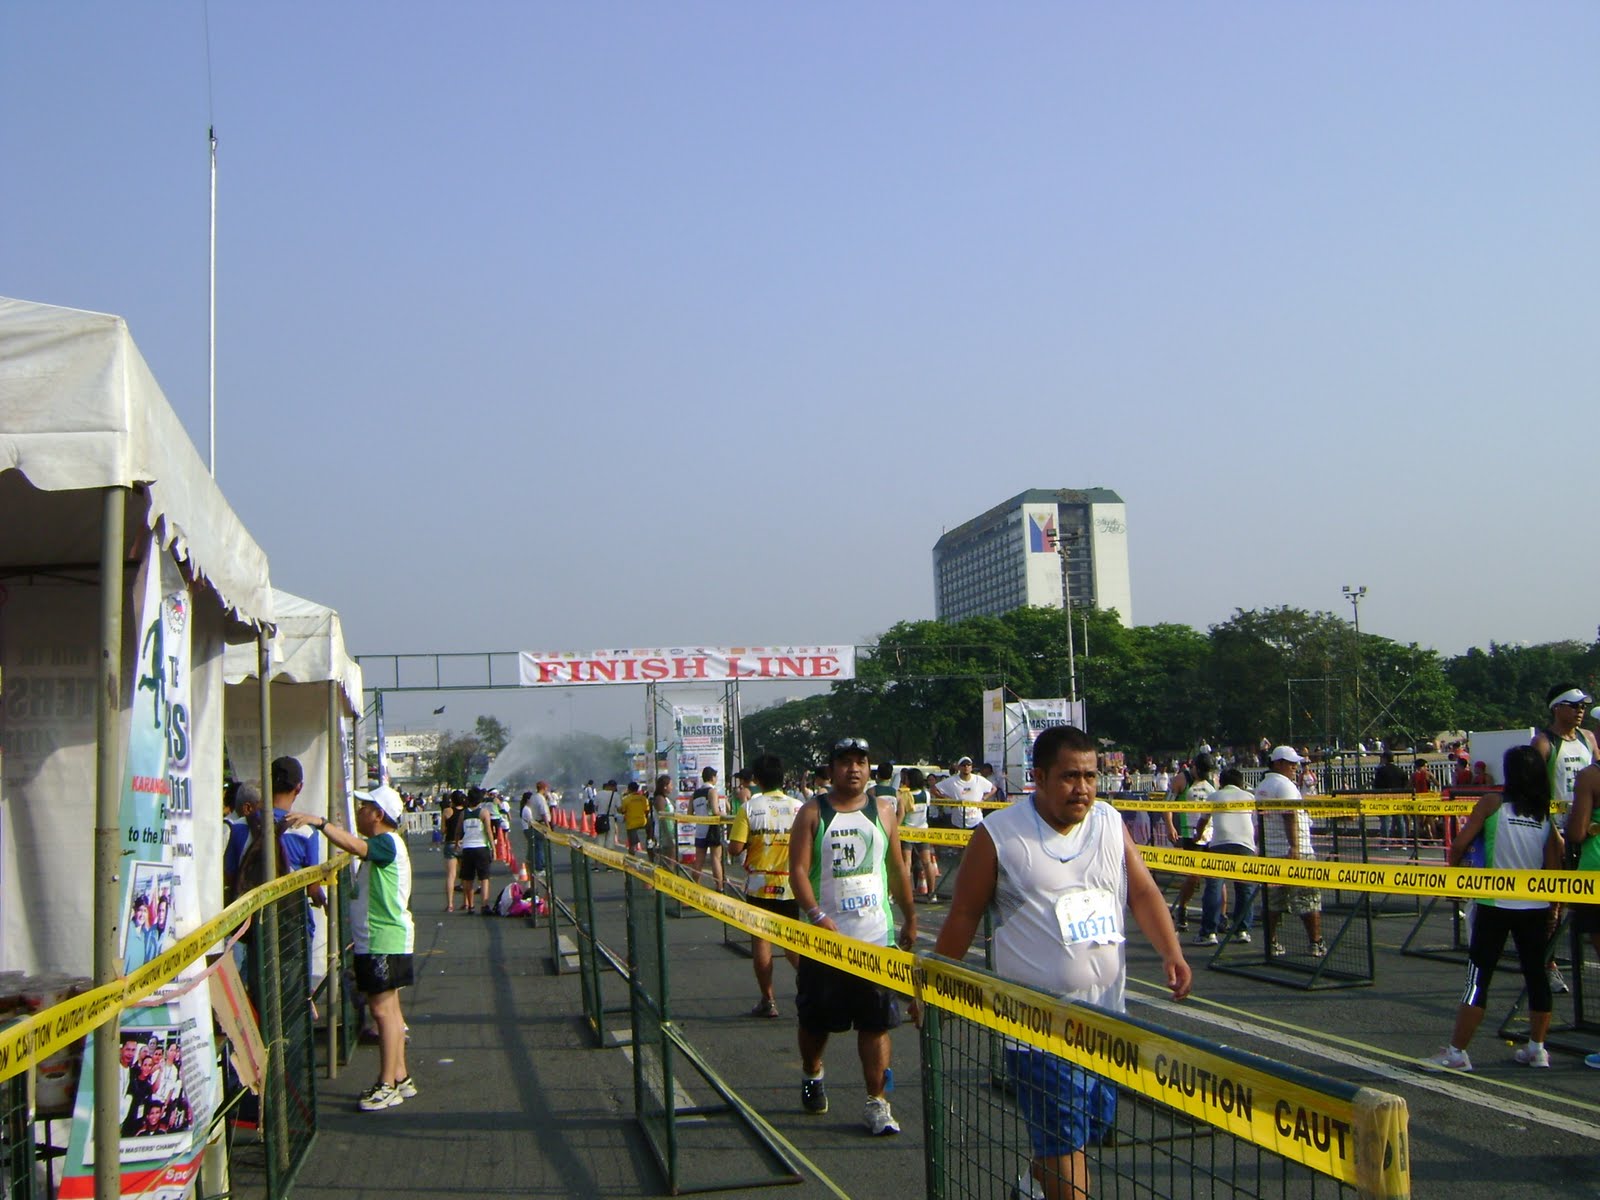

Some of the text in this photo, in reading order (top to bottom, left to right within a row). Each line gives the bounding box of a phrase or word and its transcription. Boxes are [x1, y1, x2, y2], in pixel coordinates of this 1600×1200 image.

[536, 656, 841, 682] FINISH LINE
[682, 725, 723, 736] MASTERS
[1029, 719, 1066, 730] MASTERS
[1369, 803, 1390, 811] CAUTION
[1418, 804, 1440, 812] CAUTION
[1444, 804, 1468, 812] CAUTION
[128, 826, 139, 842] to
[143, 828, 158, 844] the
[831, 828, 858, 838] RUN
[944, 833, 960, 841] CAUTION
[1141, 850, 1595, 895] TION CAUTION CAUTION CAUTION CAUTION CAUTION CAUTION CAUTION CAUTION
[1068, 915, 1116, 941] 10371
[16, 1020, 53, 1062] CAUTION
[56, 1003, 88, 1038] CAUTION
[785, 926, 810, 949] CAUTION
[813, 936, 843, 962] CAUTION
[847, 947, 882, 975] CAUTION
[935, 973, 983, 1012] CAUTION
[992, 992, 1052, 1038] CAUTION
[1064, 1018, 1139, 1074] CAUTION
[1154, 1053, 1253, 1122] CAUTION
[1274, 1099, 1350, 1160] CAUT
